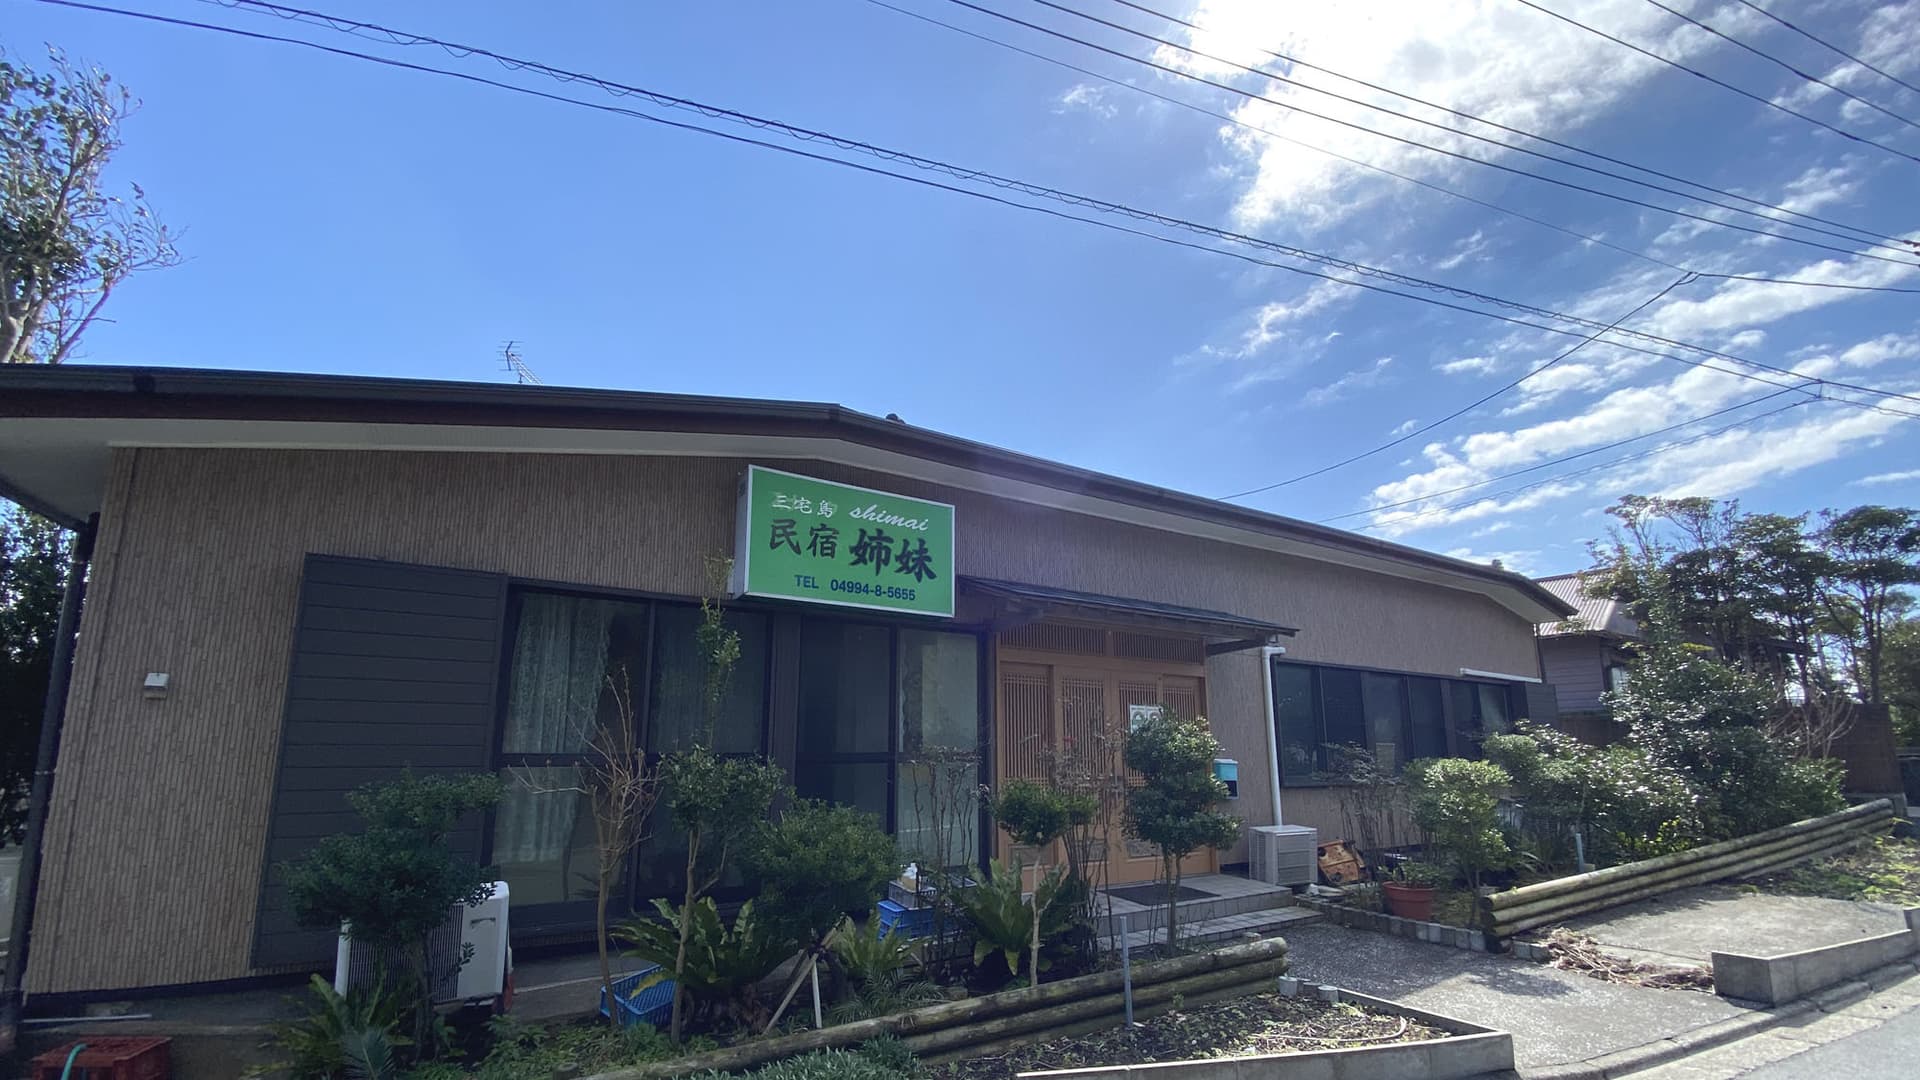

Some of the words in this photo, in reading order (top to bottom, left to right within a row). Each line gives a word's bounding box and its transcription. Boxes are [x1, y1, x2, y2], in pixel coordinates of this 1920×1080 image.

[772, 495, 834, 518] 三宅島
[849, 504, 929, 531] shimai
[769, 519, 840, 559] 民宿
[849, 527, 937, 583] 姉妹
[794, 574, 820, 590] TEL
[830, 579, 916, 601] 04994-8-5655
